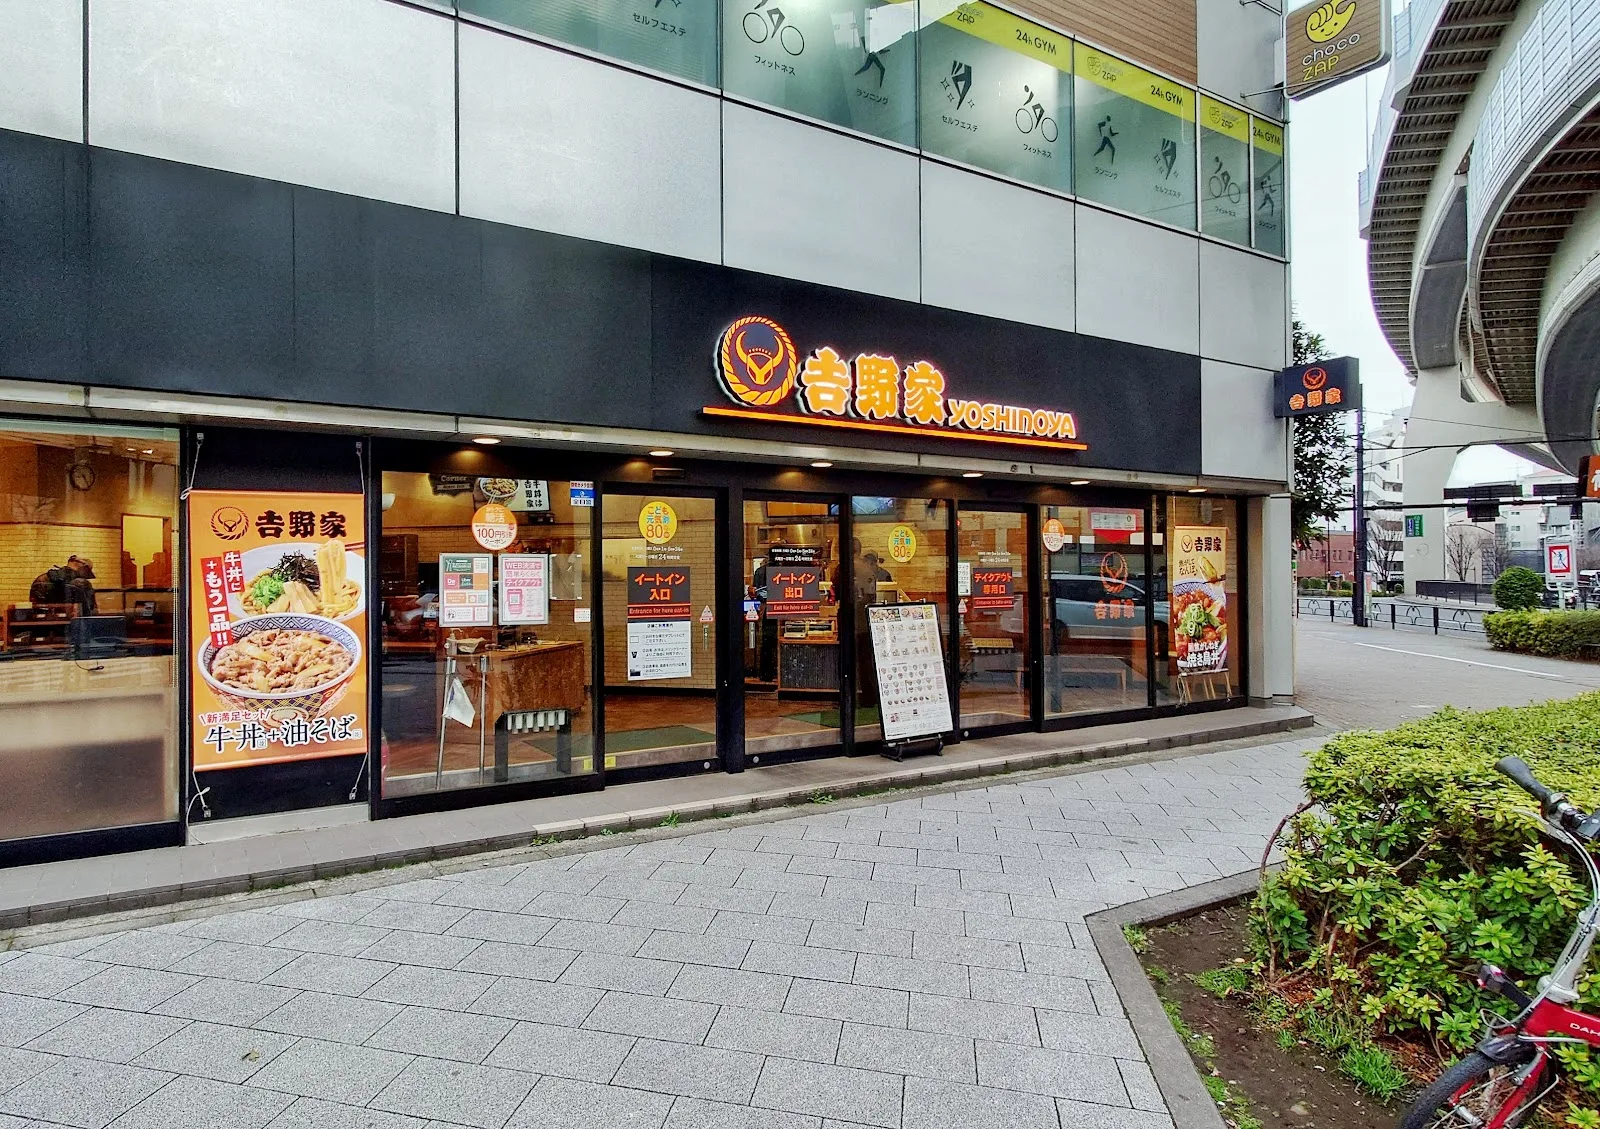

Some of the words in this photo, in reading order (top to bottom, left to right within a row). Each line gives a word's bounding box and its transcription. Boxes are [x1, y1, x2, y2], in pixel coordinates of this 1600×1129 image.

[632, 12, 687, 37] セルフエステ
[957, 12, 975, 25] ZAP
[1015, 29, 1033, 46] 24h
[1034, 37, 1057, 55] GYM
[1301, 33, 1360, 66] choco
[754, 55, 796, 76] フィットネス
[1303, 55, 1340, 82] ZAP
[1102, 71, 1117, 83] ZAP
[856, 88, 889, 105] ランニング
[1150, 85, 1165, 99] 24h
[1165, 91, 1184, 107] GYM
[941, 114, 978, 132] セルフエステ
[1264, 132, 1281, 145] GYM
[1023, 143, 1052, 159] フィットネス
[948, 399, 1077, 439] YOSHINOYA
[647, 505, 669, 515] こども
[224, 551, 243, 592] 牛丼に
[772, 572, 816, 585] イートイン
[974, 572, 1013, 583] テイクアウト
[505, 579, 542, 587] テイクアウト
[634, 573, 686, 587] イートイン
[649, 588, 672, 601] 入口
[784, 586, 803, 598] 出口
[1186, 650, 1221, 668] 焼き鳥丼
[206, 709, 266, 723] 新満足セット
